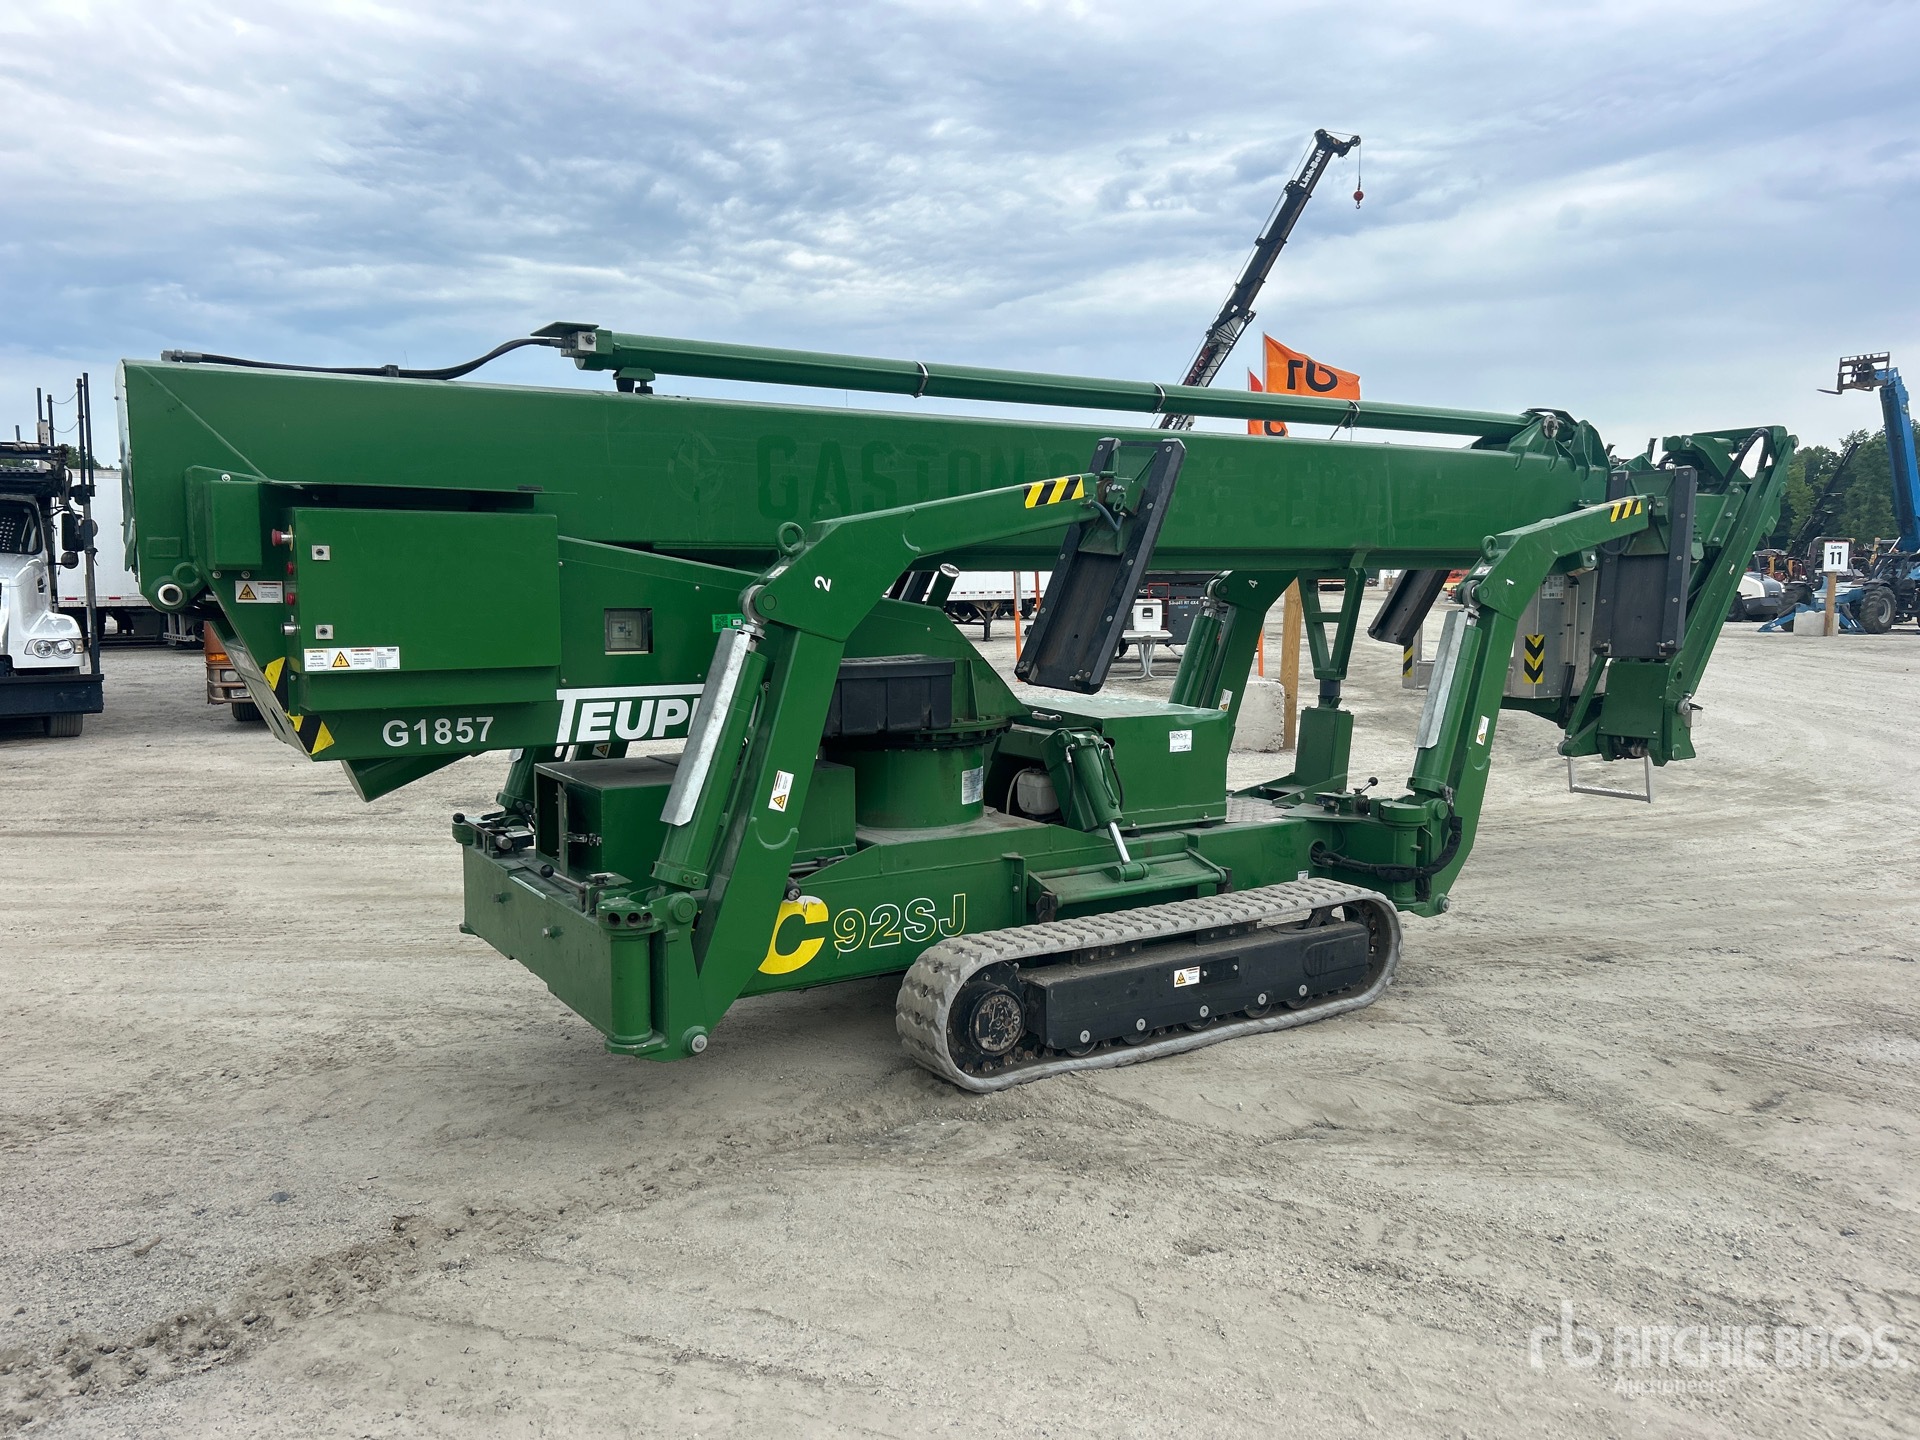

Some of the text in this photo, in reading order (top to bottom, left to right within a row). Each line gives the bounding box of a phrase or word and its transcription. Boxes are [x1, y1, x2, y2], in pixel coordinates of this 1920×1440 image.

[1829, 551, 1842, 565] 11
[814, 575, 832, 592] 2
[1248, 579, 1258, 589] 4
[382, 716, 494, 747] G1857
